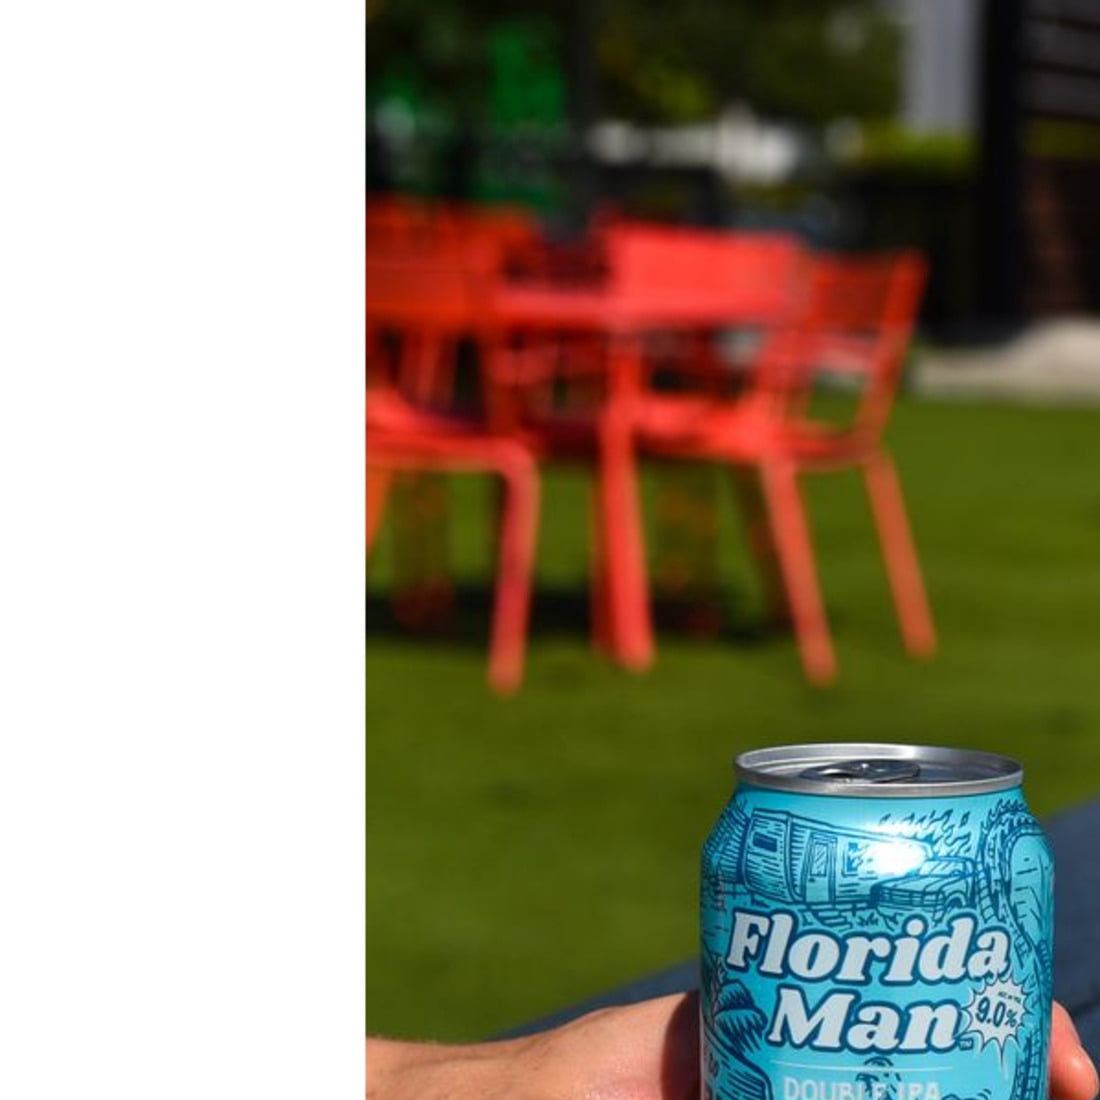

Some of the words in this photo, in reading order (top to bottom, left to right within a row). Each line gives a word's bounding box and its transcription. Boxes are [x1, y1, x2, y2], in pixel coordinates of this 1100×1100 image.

[726, 911, 1011, 982] Florida
[768, 987, 960, 1050] Man
[975, 996, 1018, 1028] 9.0%
